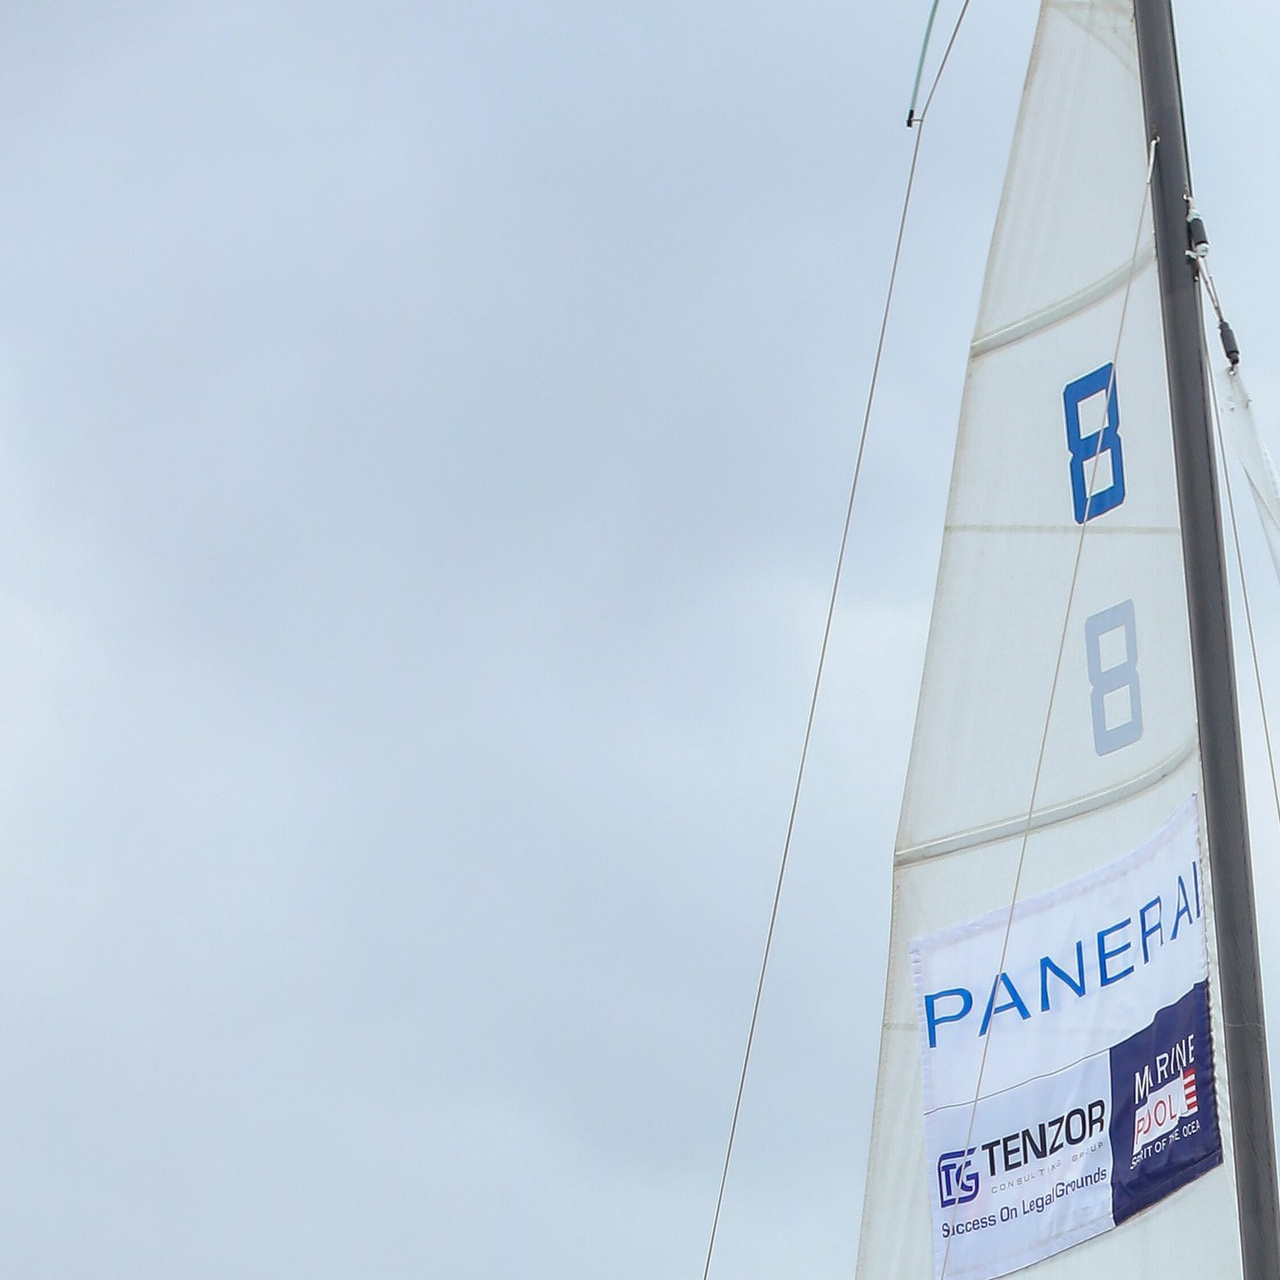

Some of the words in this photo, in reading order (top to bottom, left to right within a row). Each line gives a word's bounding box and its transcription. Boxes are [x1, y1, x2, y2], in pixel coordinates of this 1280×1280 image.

[1063, 361, 1125, 524] 8
[1084, 599, 1143, 756] 8
[924, 861, 1200, 1048] PANERAI
[1134, 1034, 1194, 1104] MRINE
[981, 1099, 1105, 1177] TENZOR
[1000, 1206, 1018, 1222] On
[1022, 1187, 1054, 1215] Legal
[1055, 1167, 1107, 1198] Grounds
